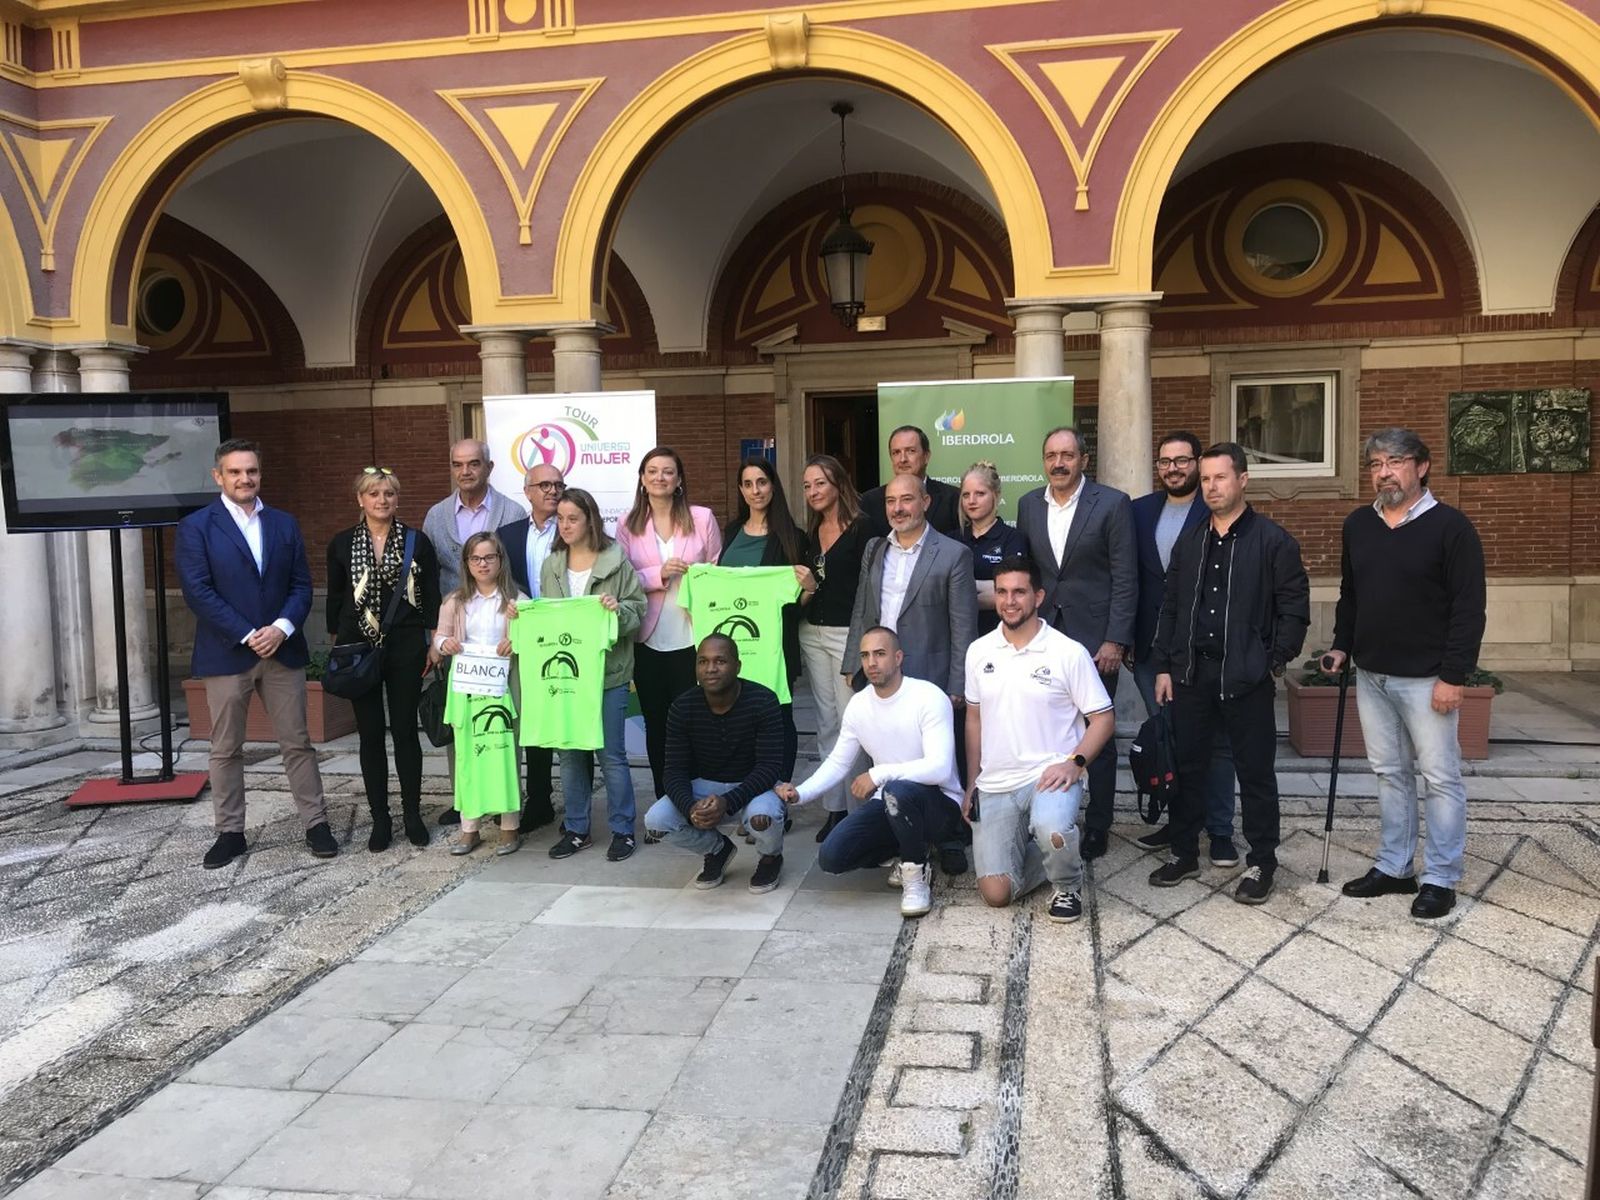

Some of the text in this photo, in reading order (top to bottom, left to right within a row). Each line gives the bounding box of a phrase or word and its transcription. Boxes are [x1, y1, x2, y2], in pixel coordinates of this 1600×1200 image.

[565, 405, 598, 429] TOUR
[941, 433, 1015, 446] IBERDROLA
[580, 441, 631, 452] UNIVERSO
[581, 452, 631, 465] MUJER
[456, 662, 506, 678] BLANCA
